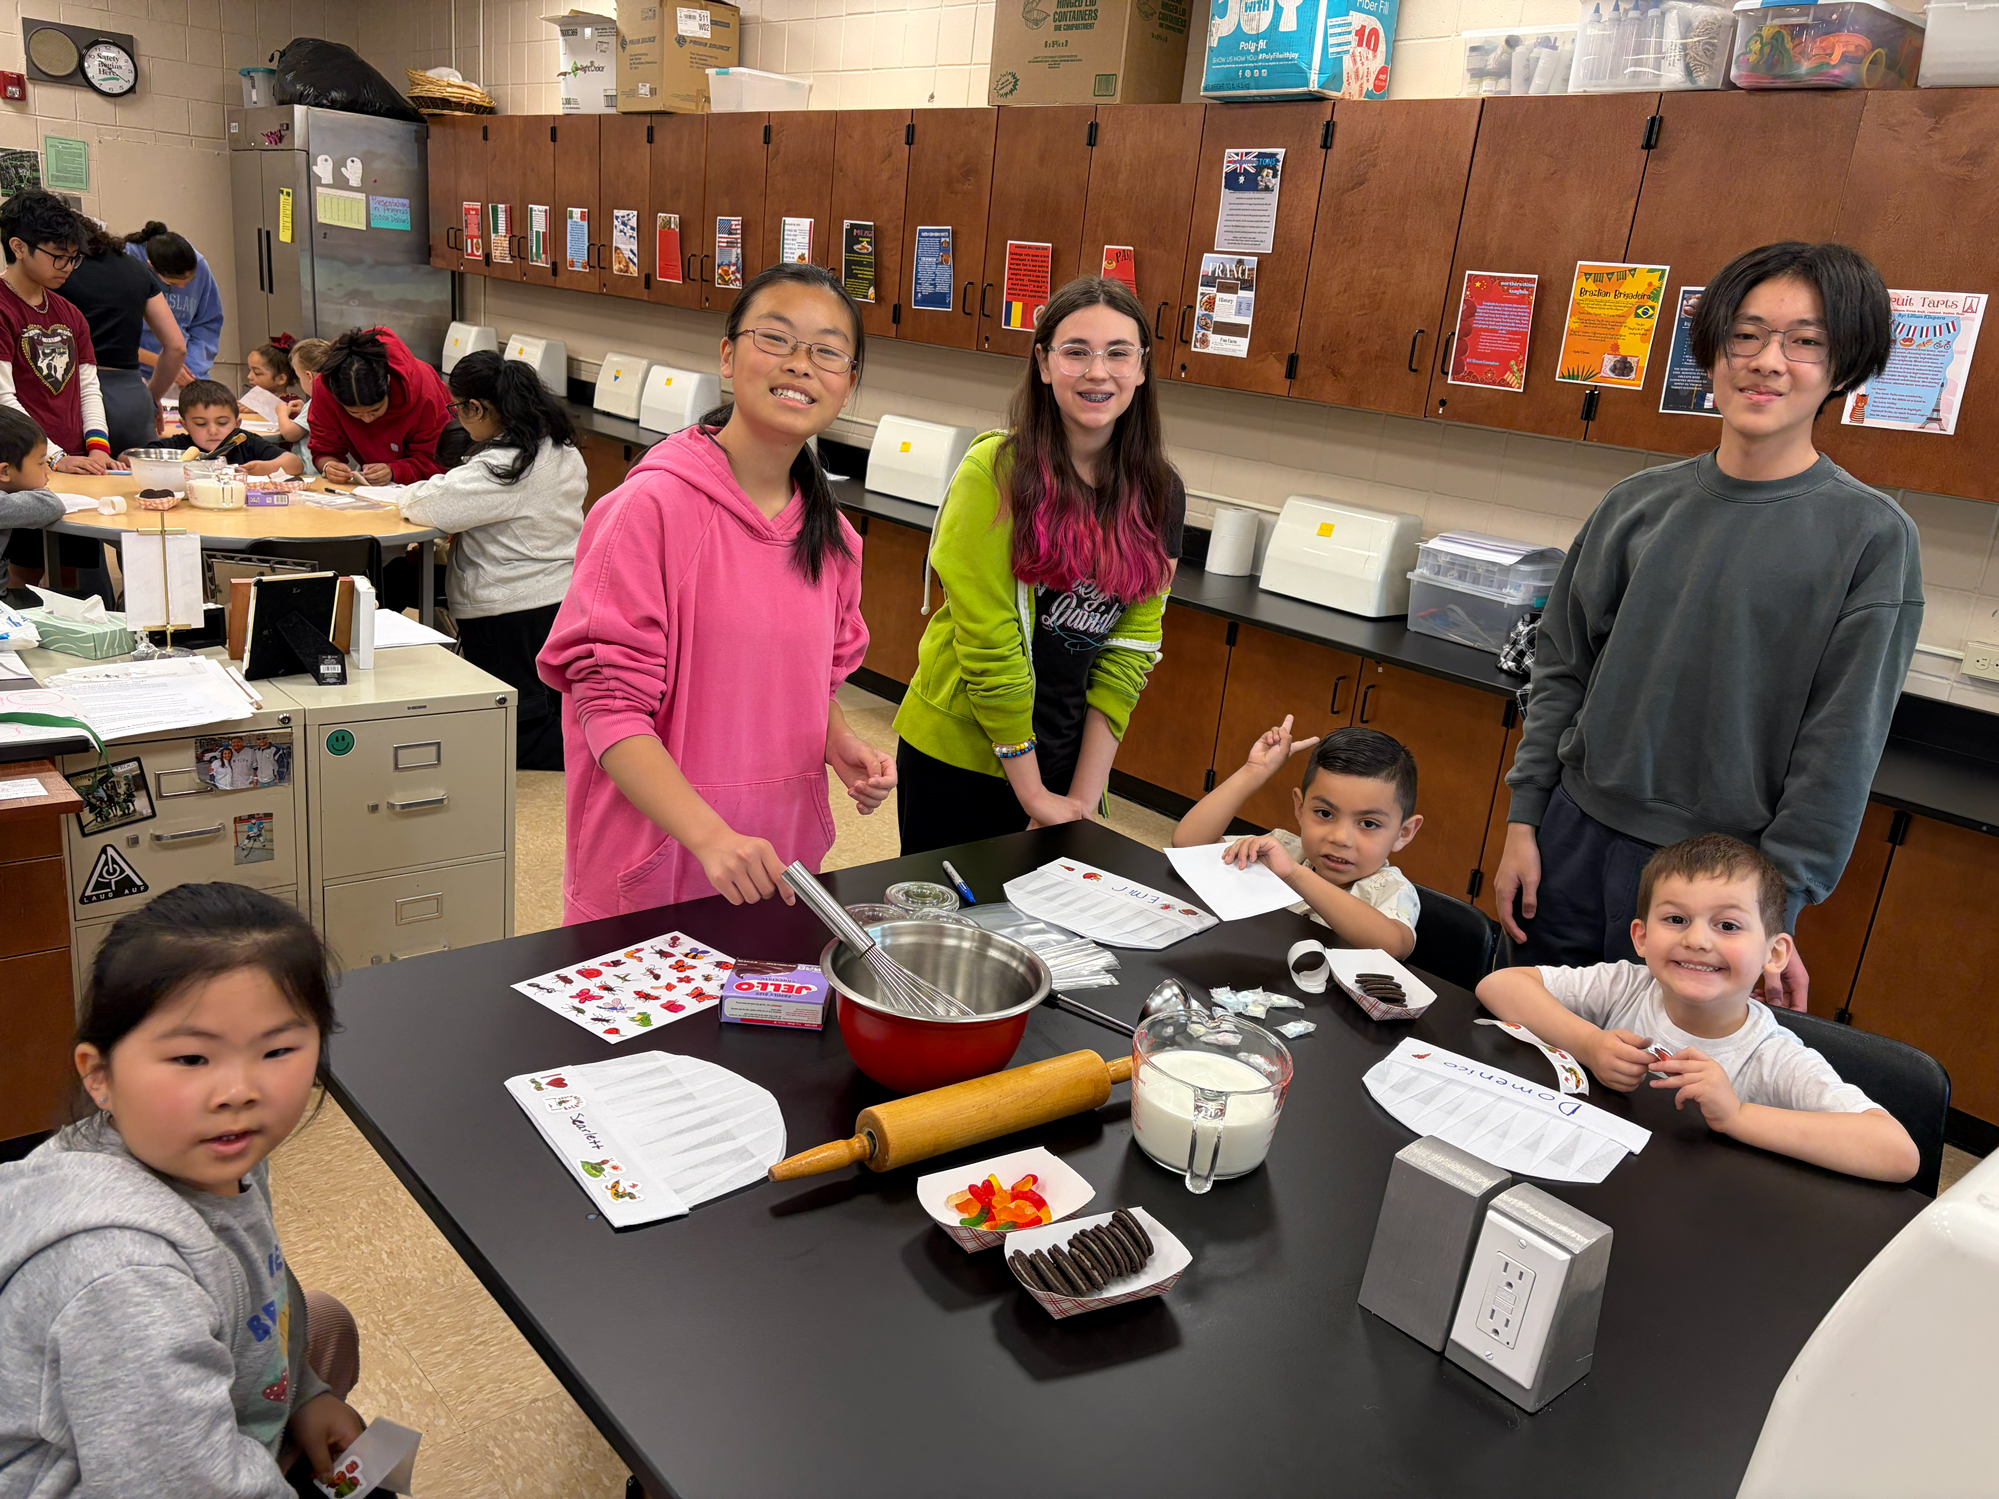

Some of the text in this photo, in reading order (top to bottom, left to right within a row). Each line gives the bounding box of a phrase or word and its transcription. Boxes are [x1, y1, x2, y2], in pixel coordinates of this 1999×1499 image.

[1053, 9, 1098, 22] CONTAINERS
[1355, 25, 1379, 53] 10
[1208, 262, 1251, 279] FRANCE
[1920, 296, 1959, 309] Tarts
[124, 886, 144, 894] AUF
[735, 982, 812, 994] JELL-O
[1443, 1061, 1583, 1117] Domenico
[570, 1113, 603, 1150] Scarlett
